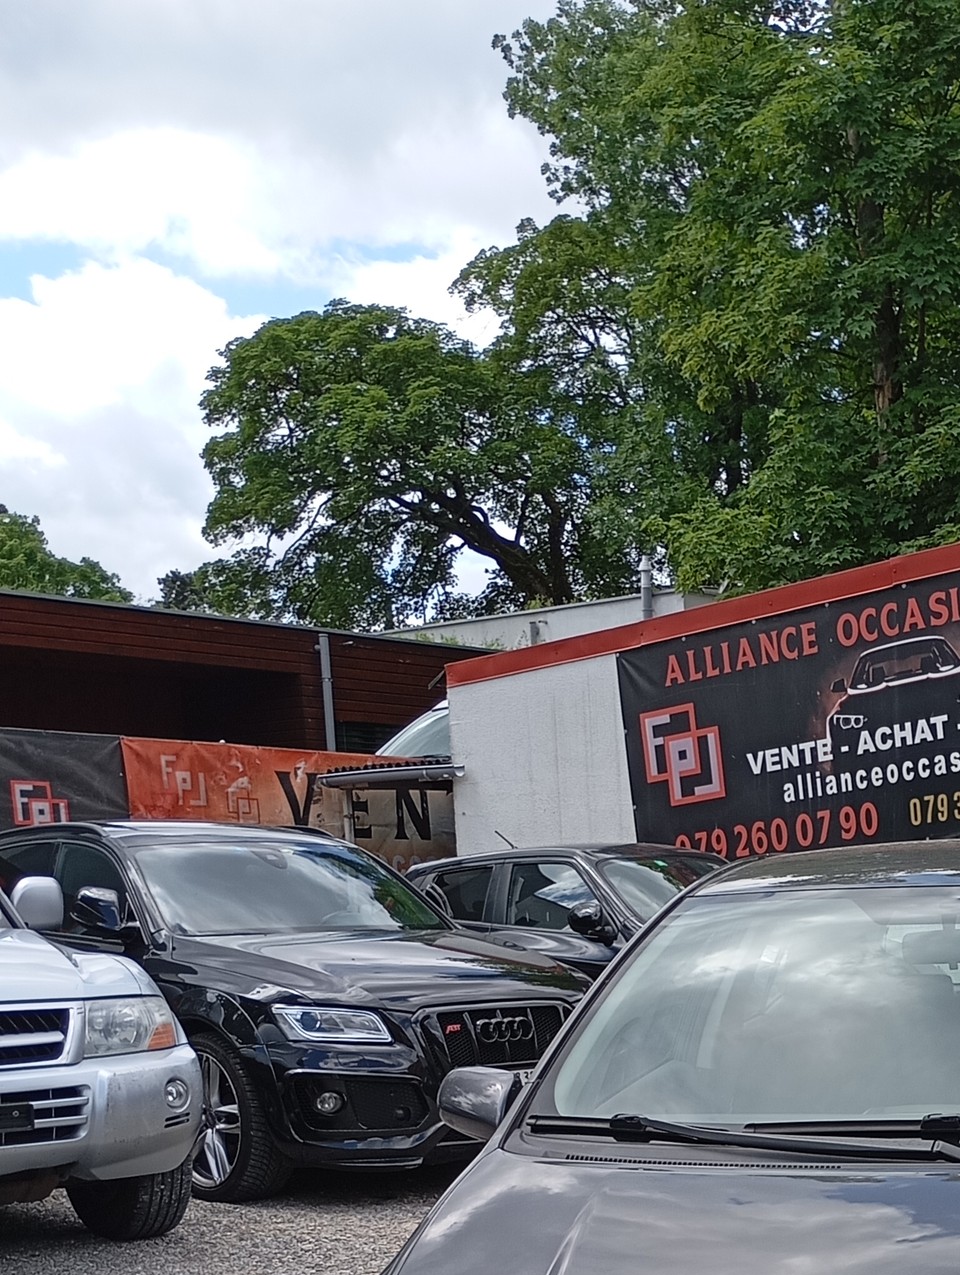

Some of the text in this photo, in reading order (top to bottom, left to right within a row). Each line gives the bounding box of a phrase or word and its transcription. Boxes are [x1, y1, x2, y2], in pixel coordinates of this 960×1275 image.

[664, 621, 819, 688] ALLIANCE
[746, 738, 834, 776] VENTE
[856, 714, 950, 755] ACHAT
[733, 817, 789, 858] 260
[795, 809, 831, 848] 07
[838, 801, 879, 840] 90
[909, 793, 949, 826] 079
